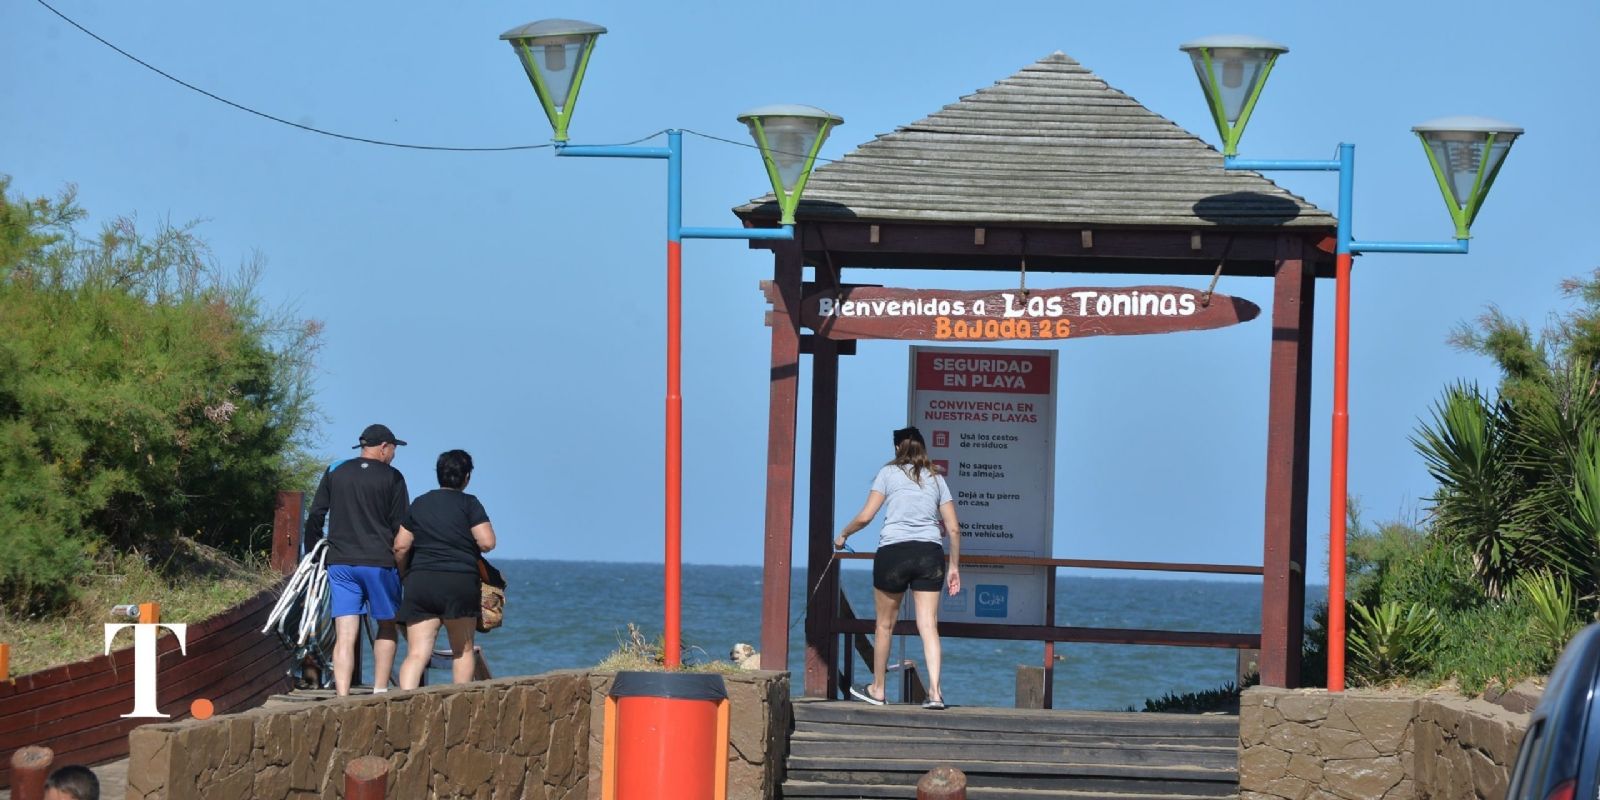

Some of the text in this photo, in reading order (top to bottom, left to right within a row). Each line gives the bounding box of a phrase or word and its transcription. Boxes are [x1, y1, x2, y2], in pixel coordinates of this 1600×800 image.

[818, 291, 1195, 317] Bienvenidos a Las Toninas
[935, 316, 1070, 339] Bajada 26
[933, 358, 1033, 373] SEGURIDAD
[943, 374, 1026, 389] EN PLAYA
[929, 400, 1033, 412] CONVIVENCIA EN
[925, 411, 1037, 423] NUESTRAS PLAYAS
[978, 433, 989, 441] los
[991, 434, 1018, 442] cestos
[972, 441, 1008, 449] residuos
[973, 463, 1002, 472] saques
[972, 470, 1005, 479] almejas
[997, 493, 1020, 501] perro
[971, 522, 1003, 531] circules
